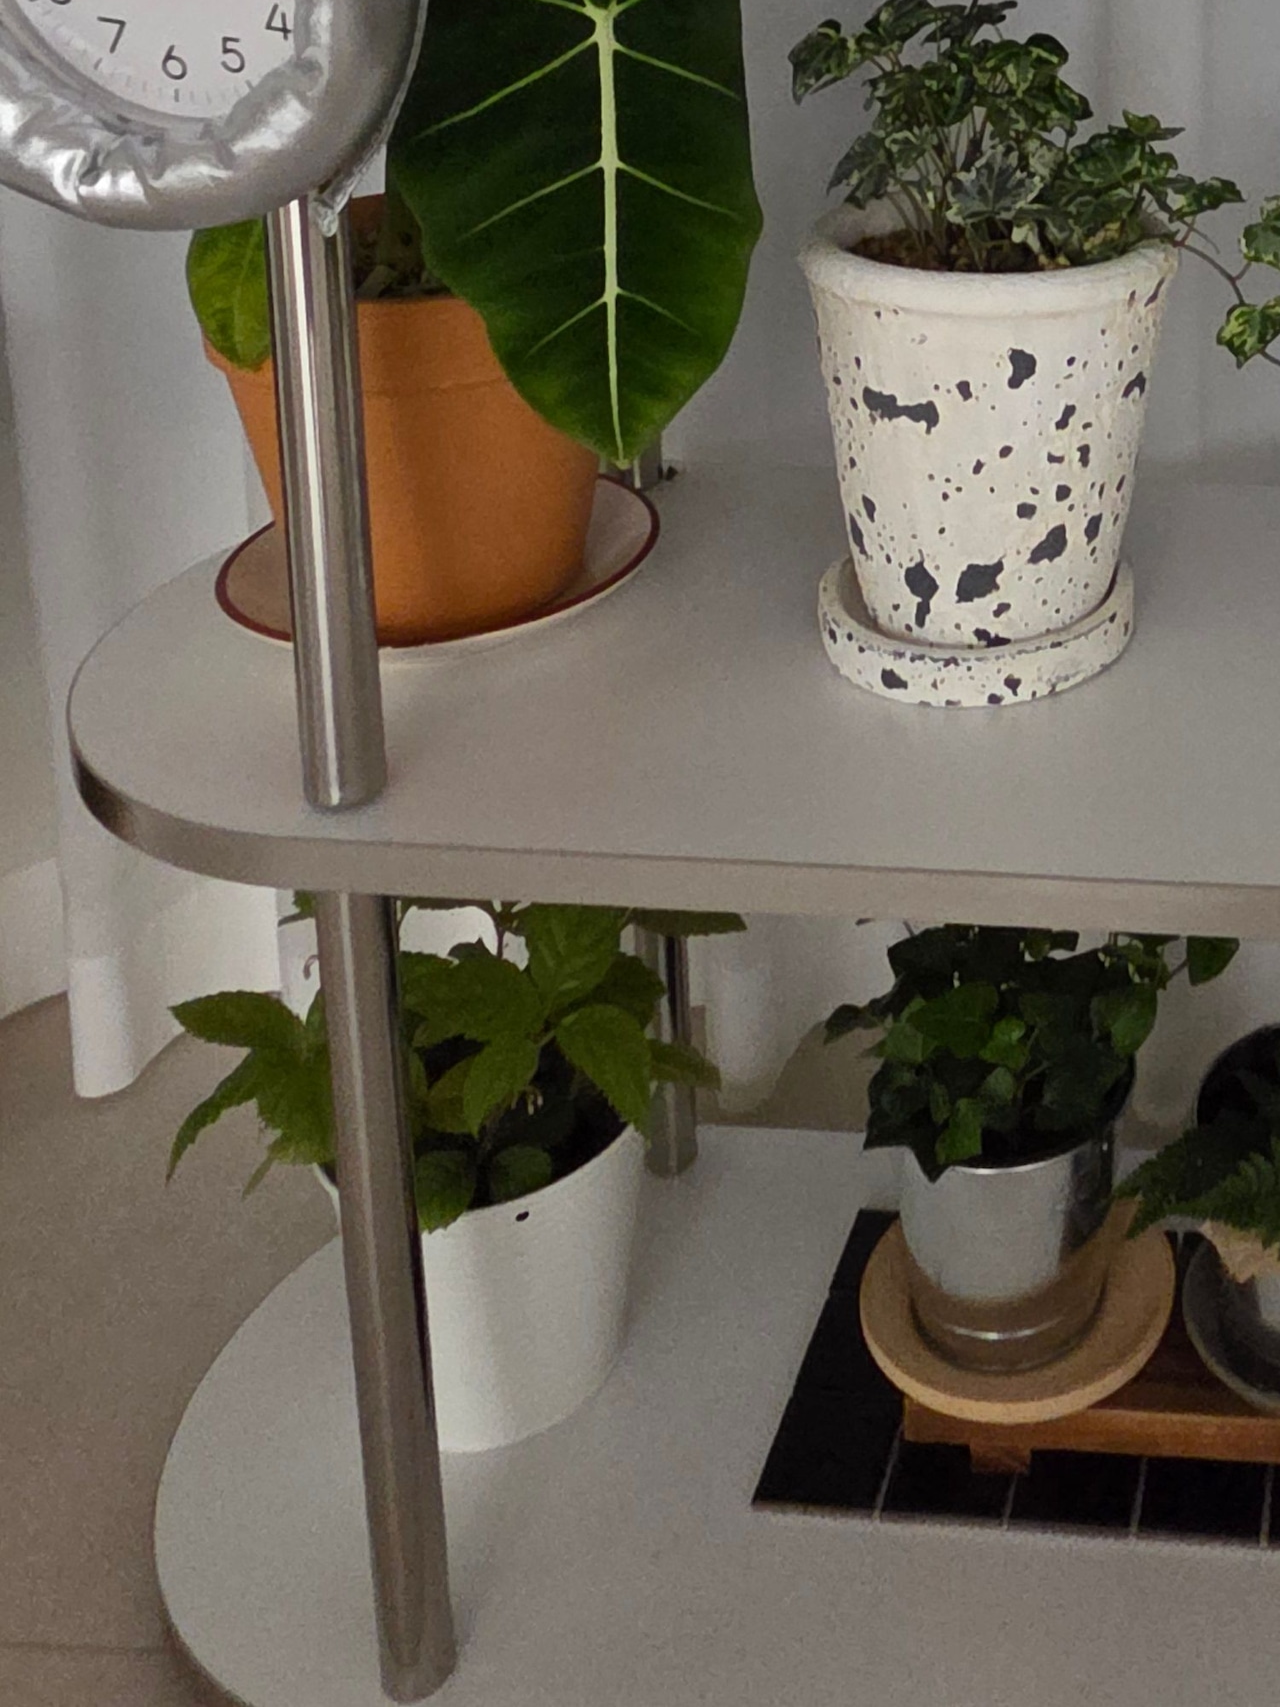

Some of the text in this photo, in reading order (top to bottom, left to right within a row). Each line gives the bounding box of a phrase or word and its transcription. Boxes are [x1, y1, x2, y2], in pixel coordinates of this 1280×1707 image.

[96, 16, 127, 54] 7
[264, 2, 293, 41] 4
[161, 44, 188, 81] 6
[220, 36, 246, 74] 5
